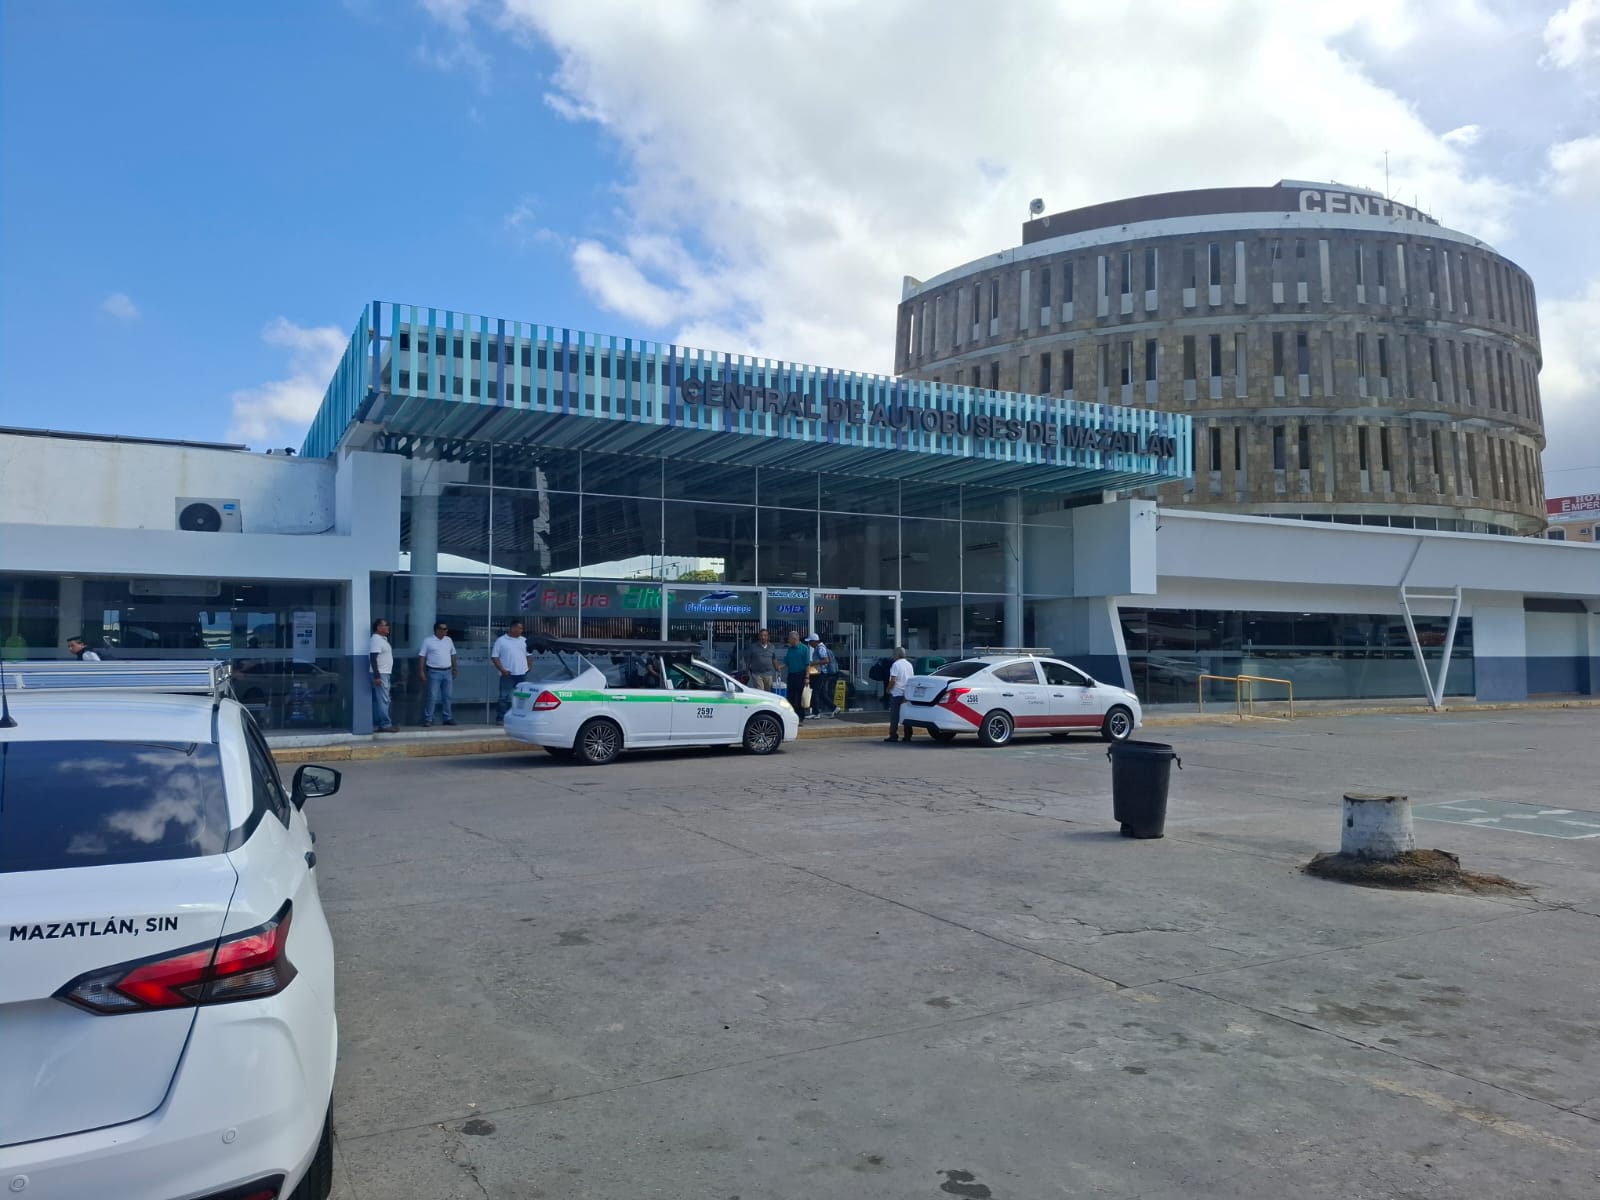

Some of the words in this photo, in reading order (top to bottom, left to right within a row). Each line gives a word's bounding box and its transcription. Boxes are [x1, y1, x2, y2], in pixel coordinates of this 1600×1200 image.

[681, 376, 821, 420] CENTRAL
[827, 397, 865, 425] DE
[869, 401, 1024, 442] AUTOBUSES
[1026, 419, 1058, 446] DE
[1063, 424, 1177, 459] MAZATLÁN
[543, 588, 609, 608] Futura
[622, 587, 675, 609] Elite
[697, 707, 714, 715] 2597
[9, 916, 139, 942] MAZATLÁN,
[145, 916, 179, 933] SIN
